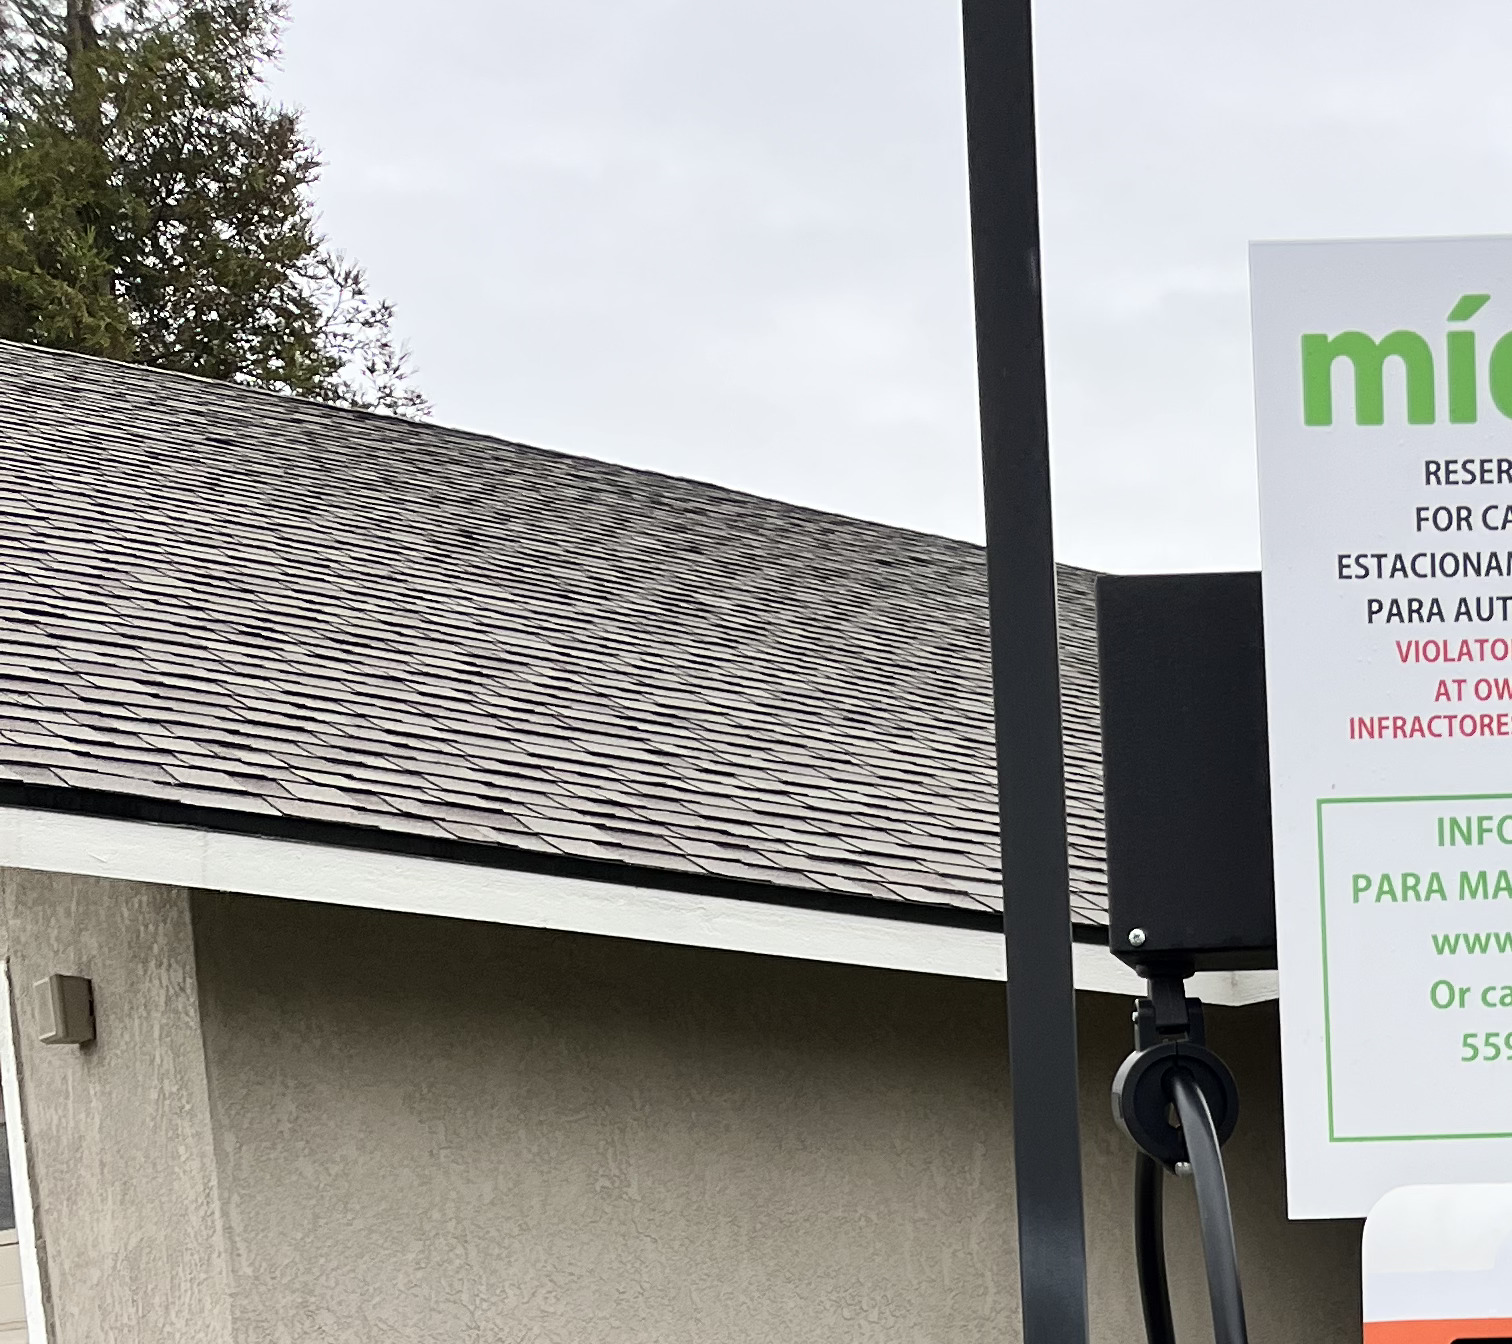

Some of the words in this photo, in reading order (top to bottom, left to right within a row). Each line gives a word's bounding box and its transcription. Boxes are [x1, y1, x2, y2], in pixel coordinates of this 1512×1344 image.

[1416, 506, 1473, 532] FOR
[1368, 598, 1445, 624] PARA
[1435, 679, 1467, 702] AT
[1352, 872, 1447, 903] PARA
[1430, 980, 1471, 1009] Or
